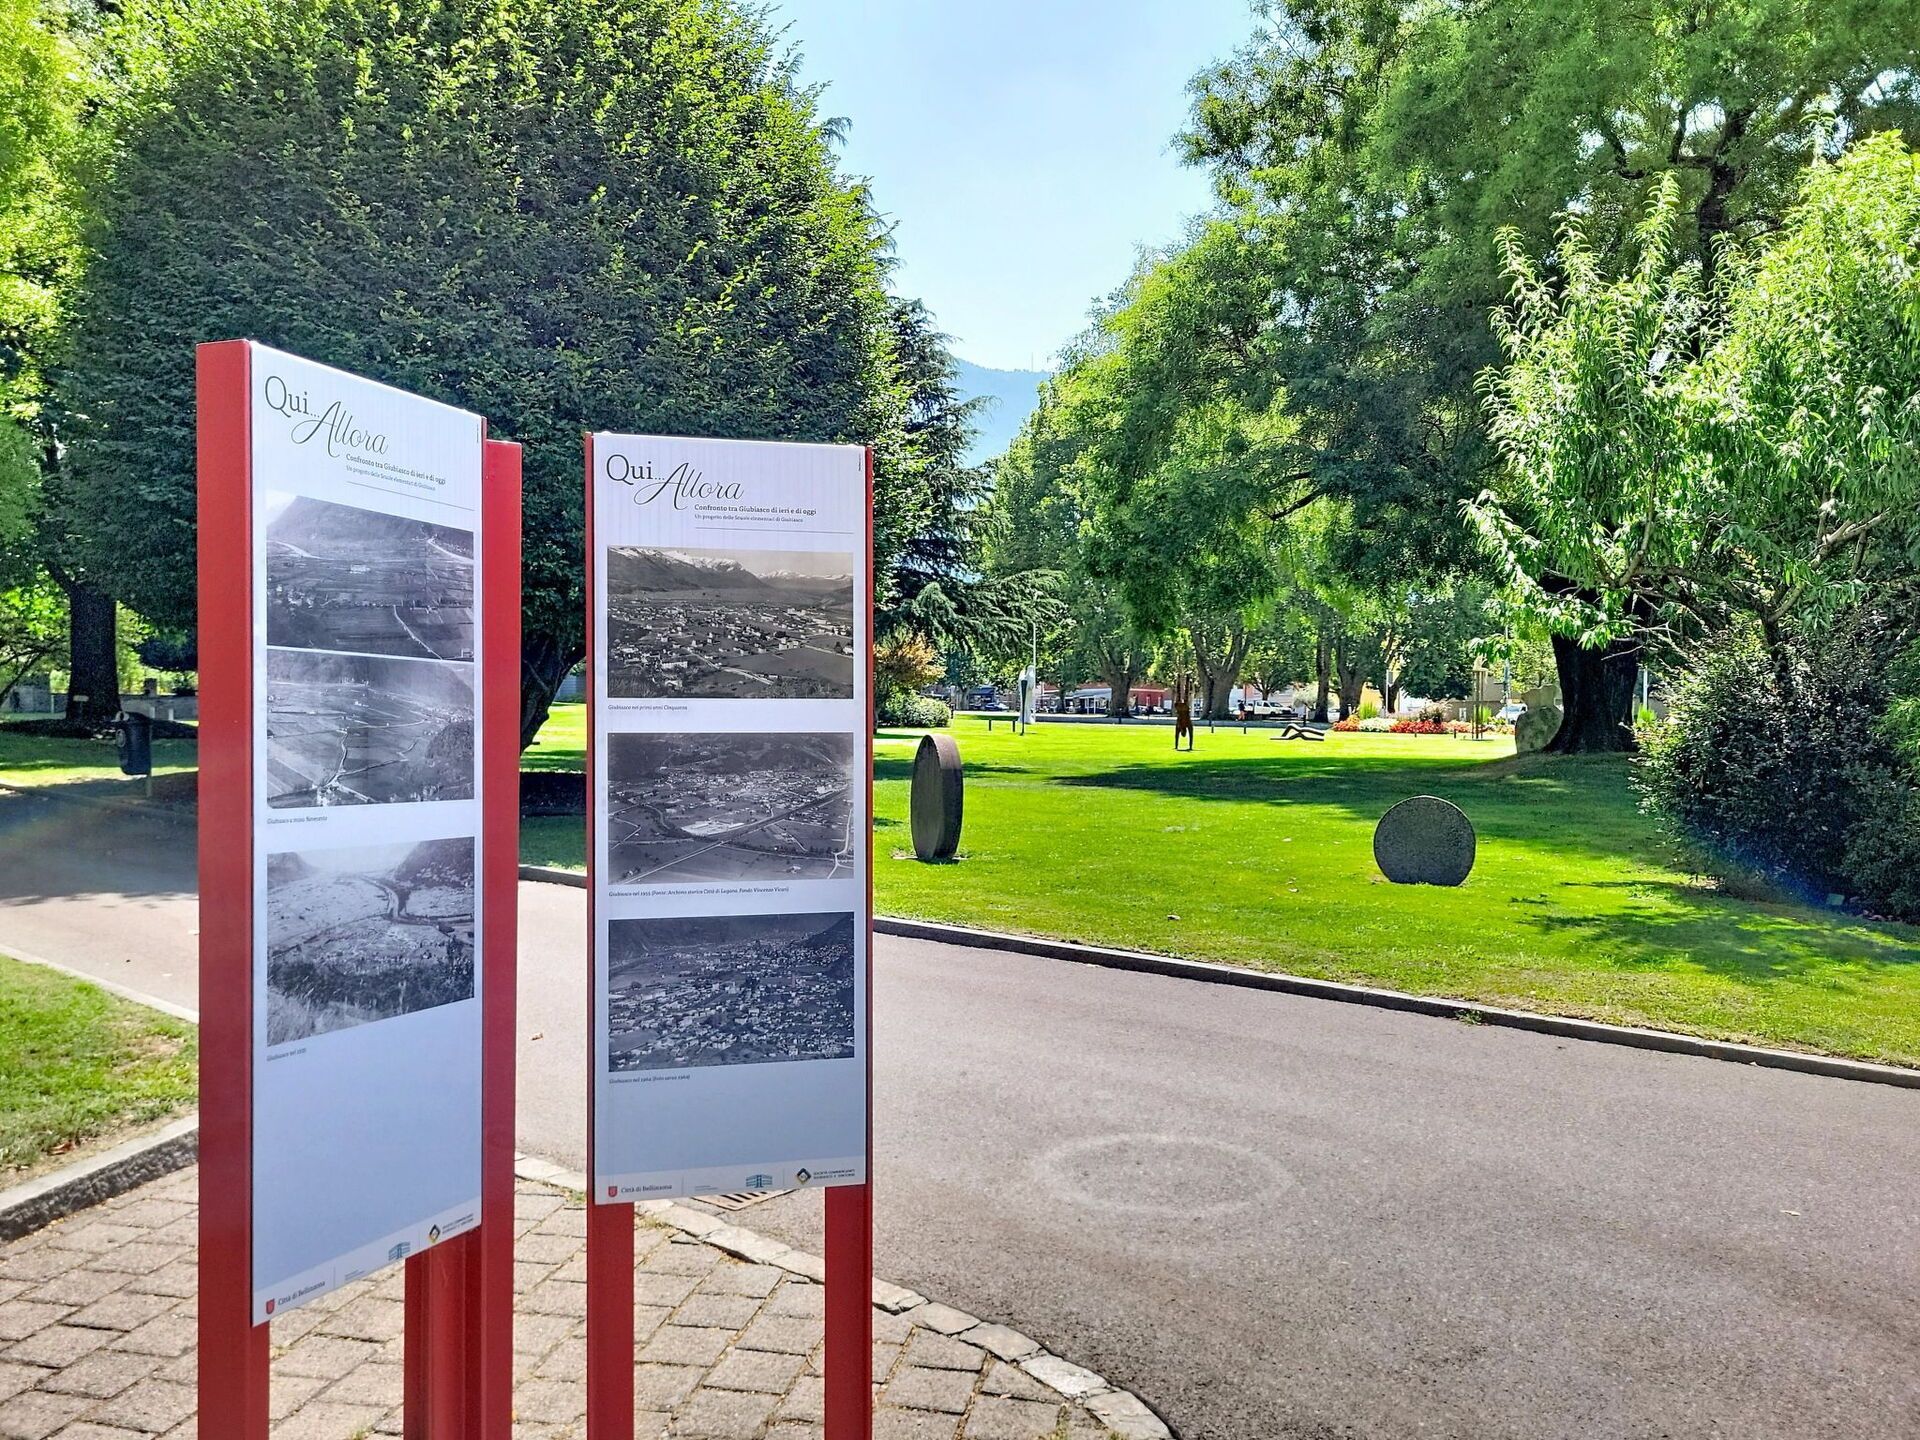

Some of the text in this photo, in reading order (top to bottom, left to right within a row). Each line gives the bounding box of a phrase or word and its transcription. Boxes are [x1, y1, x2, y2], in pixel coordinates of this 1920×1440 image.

[291, 401, 389, 458] Allora
[346, 453, 375, 467] Confronto
[375, 460, 383, 469] tra
[384, 463, 409, 475] Giubiasco
[411, 469, 416, 477] di
[633, 462, 744, 510] Allora
[694, 504, 728, 512] Confronto
[802, 508, 817, 516] oggi
